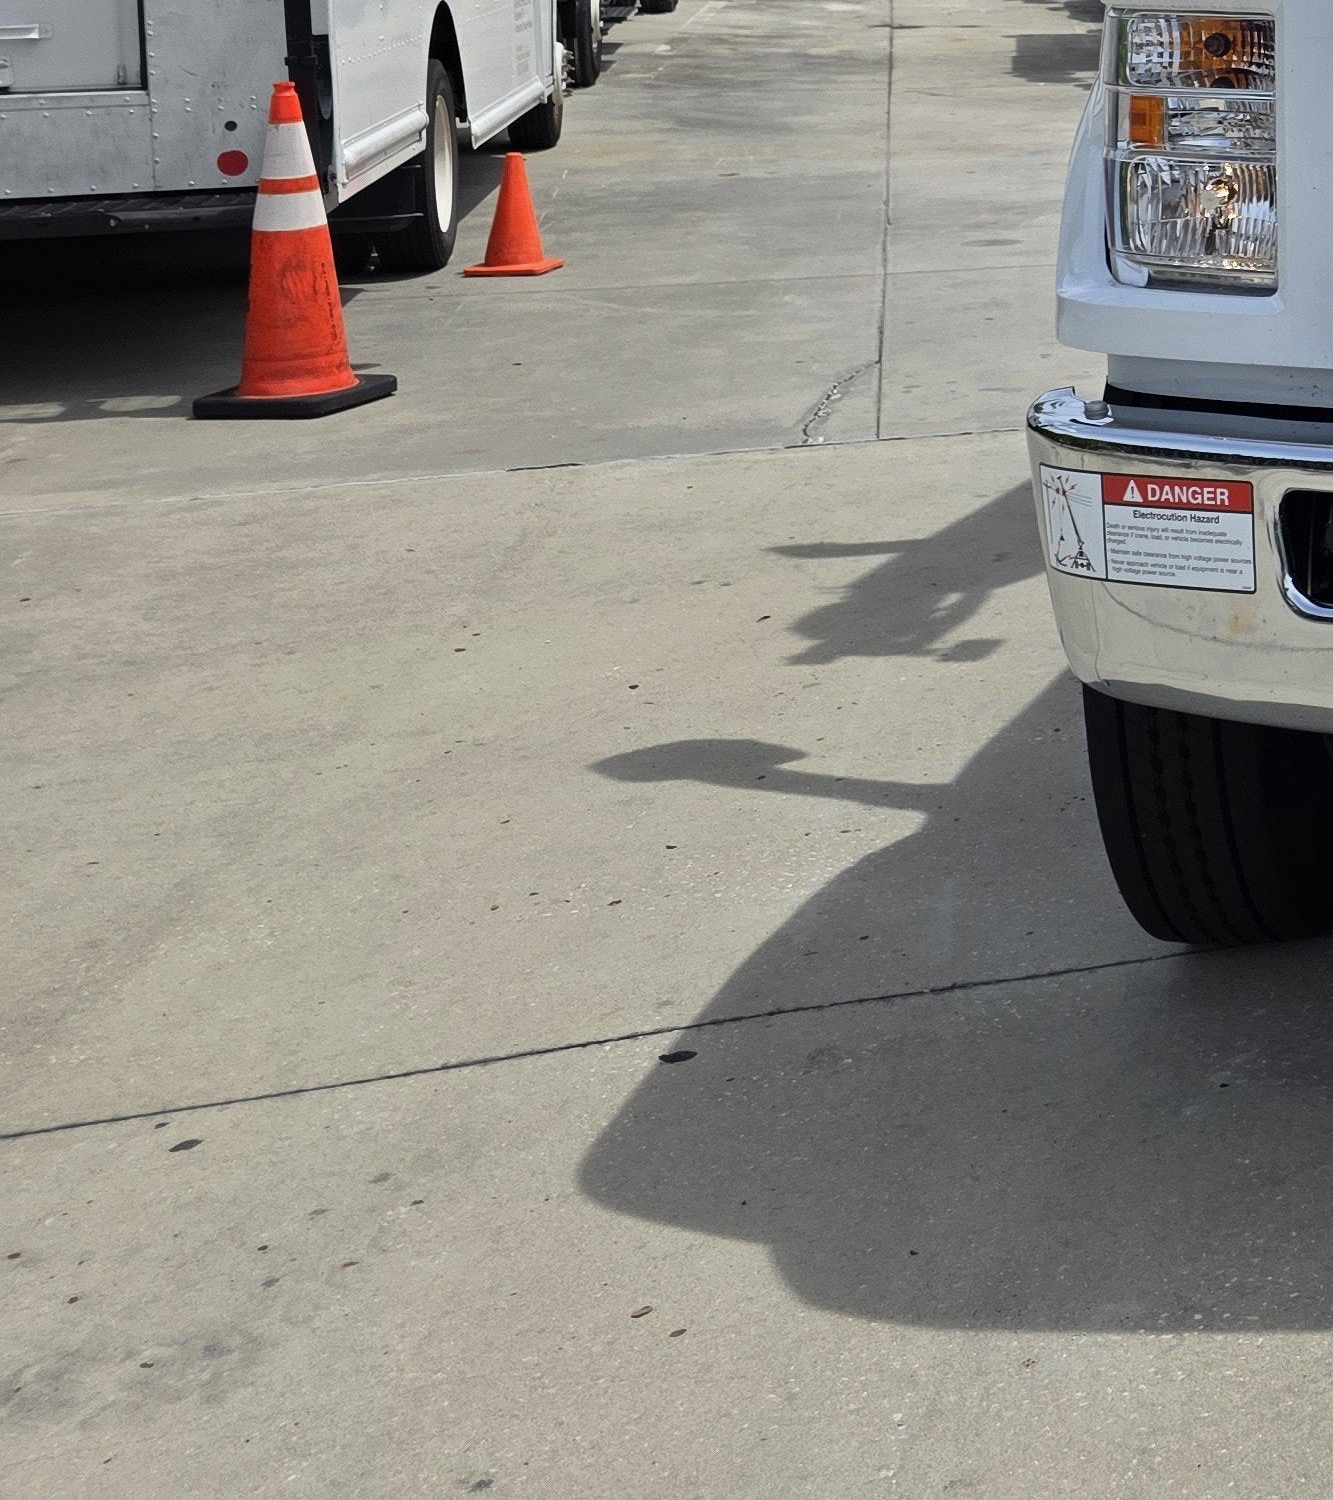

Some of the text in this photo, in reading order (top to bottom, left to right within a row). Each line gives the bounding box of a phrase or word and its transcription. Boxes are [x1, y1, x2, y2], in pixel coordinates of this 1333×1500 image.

[1147, 484, 1229, 505] DANGER
[1133, 510, 1220, 524] Electrocution Hazard
